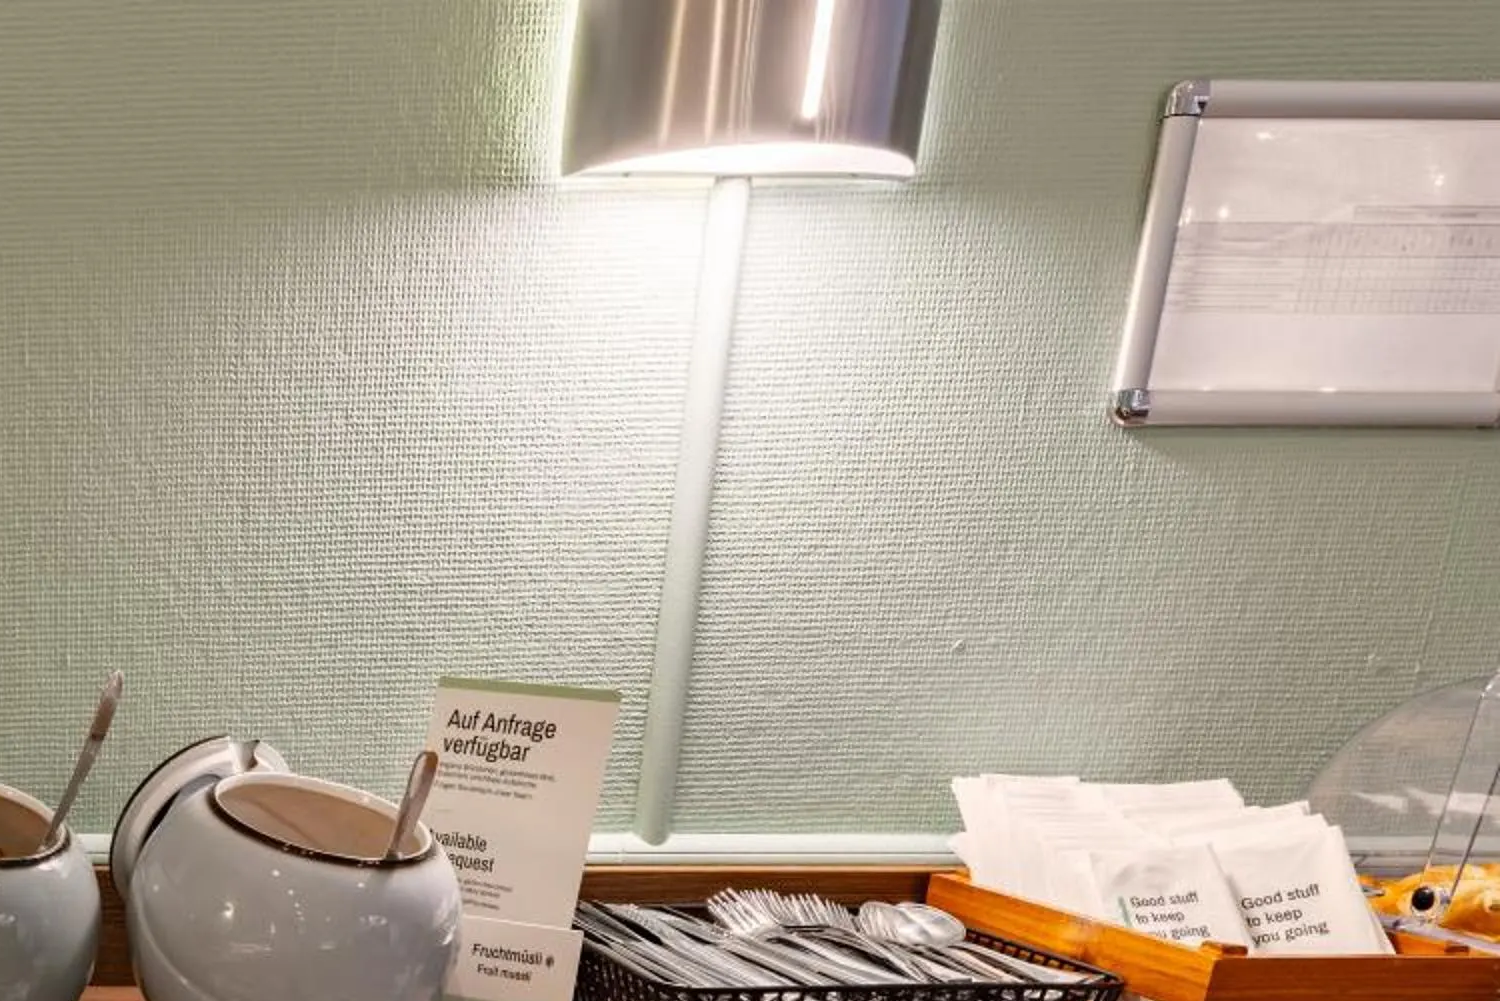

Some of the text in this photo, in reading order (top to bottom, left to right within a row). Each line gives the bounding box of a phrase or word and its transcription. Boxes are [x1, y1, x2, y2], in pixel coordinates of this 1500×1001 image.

[447, 708, 557, 743] Auf Anfrage
[443, 736, 531, 763] verfügbar
[447, 851, 495, 873] equest
[1130, 890, 1200, 909] Good stuff
[1241, 883, 1321, 911] Good stuff
[1135, 913, 1149, 924] to
[1246, 907, 1303, 928] to keep
[1251, 921, 1330, 948] you going
